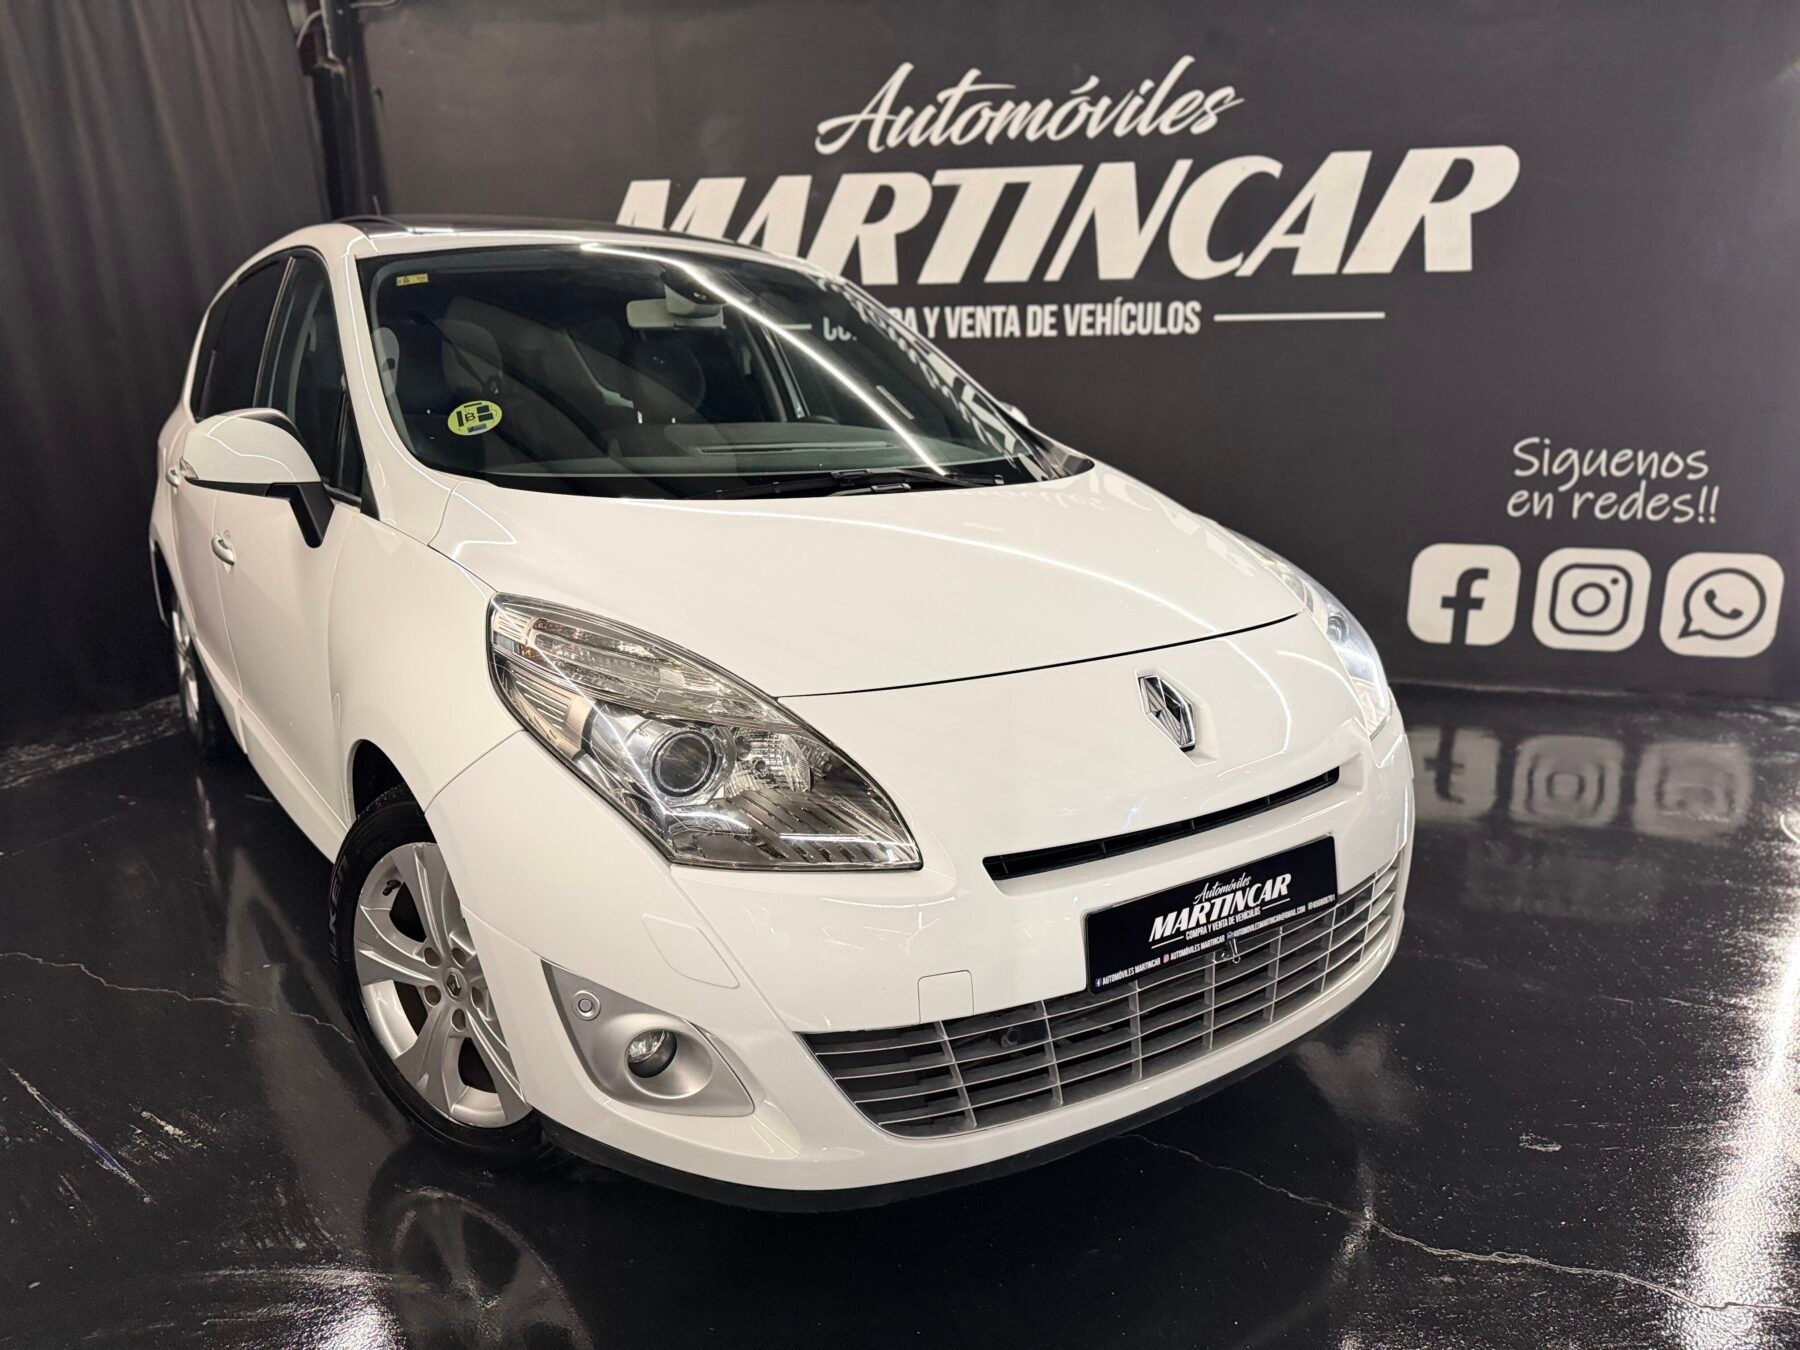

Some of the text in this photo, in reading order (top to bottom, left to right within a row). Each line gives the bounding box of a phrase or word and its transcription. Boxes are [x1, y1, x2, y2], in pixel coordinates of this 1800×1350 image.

[814, 54, 1246, 156] Automóviles
[922, 306, 941, 339] Y
[944, 304, 1021, 339] VENTA
[1026, 304, 1059, 337] DE
[1063, 297, 1201, 337] VEHÍCULOS
[1512, 436, 1710, 492] Siguenos
[1506, 480, 1720, 524] en redes!!
[1148, 873, 1292, 942] MARTINCAR
[1192, 872, 1252, 905] Automóviles
[1185, 924, 1208, 941] COMPRA
[1212, 918, 1228, 932] VENTA
[1200, 935, 1225, 950] MARTINCAR
[1134, 957, 1161, 974] MARTINCAR
